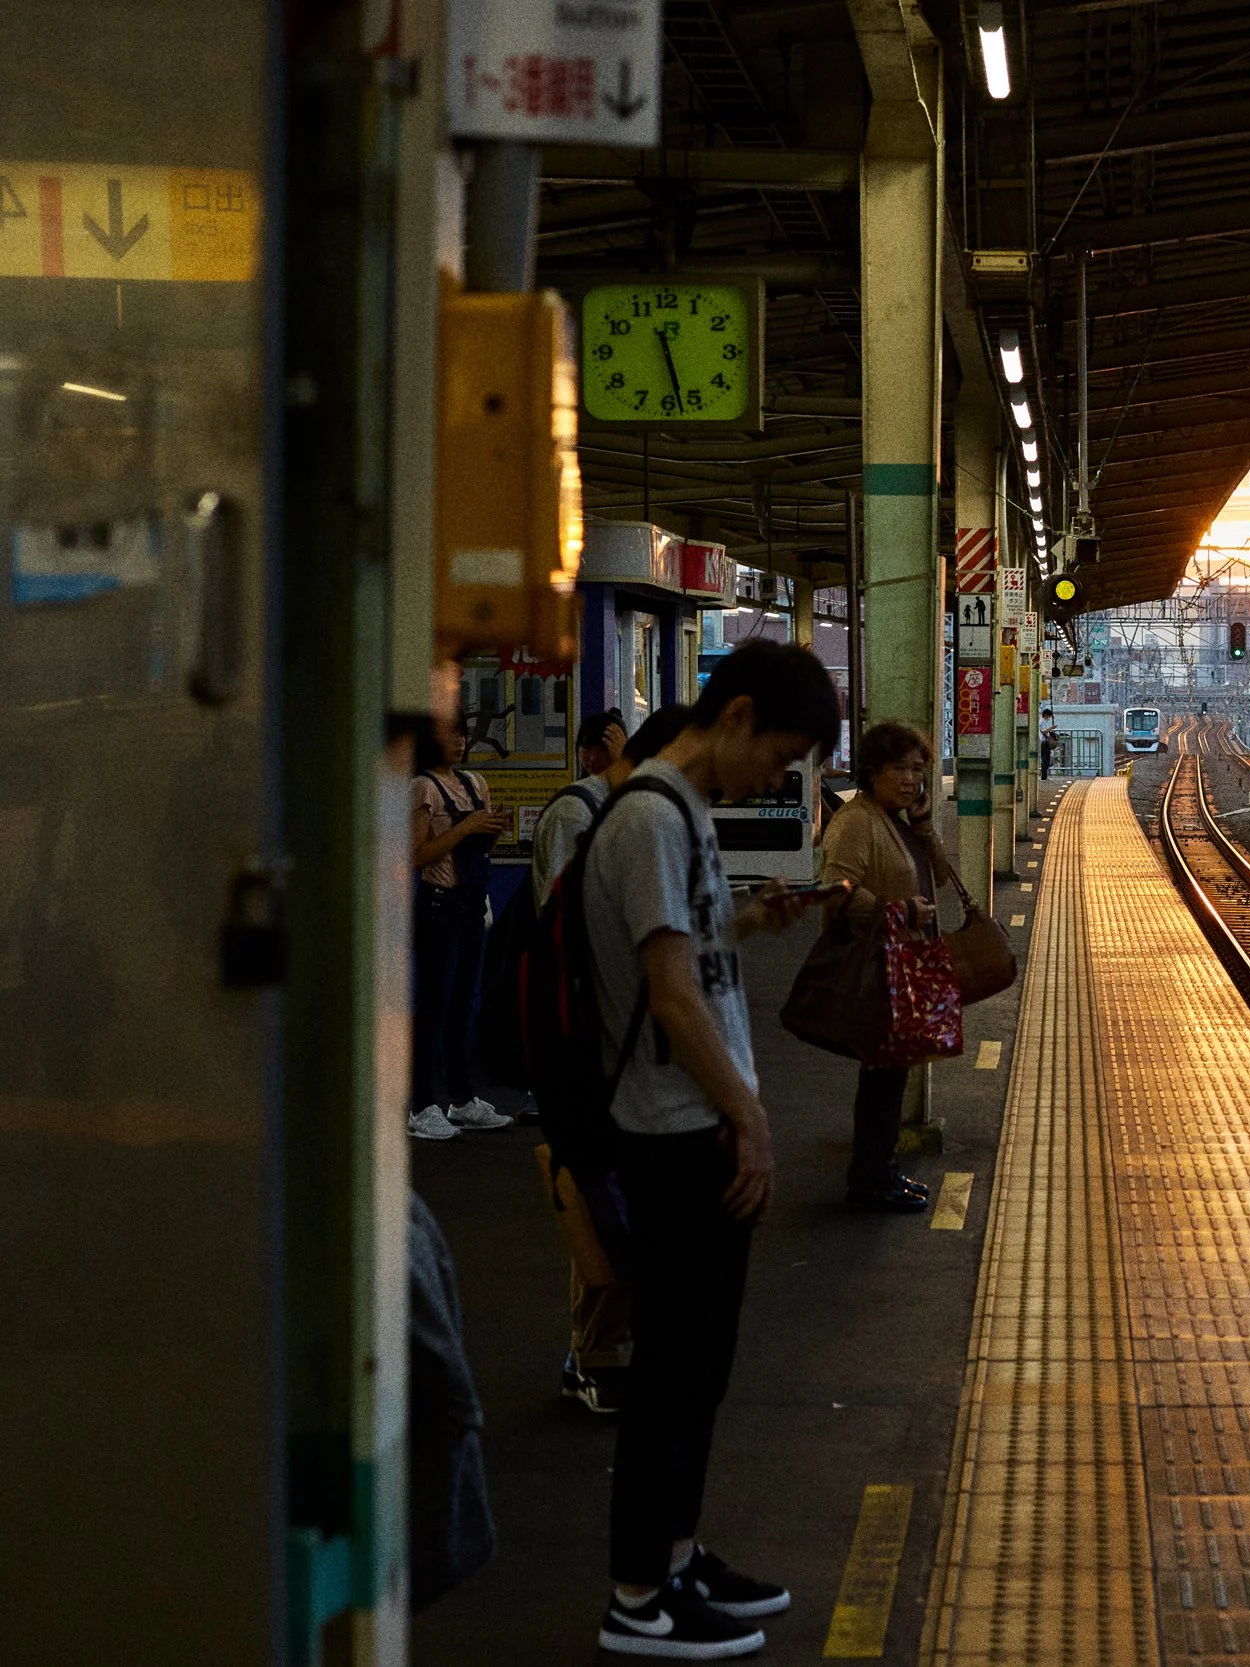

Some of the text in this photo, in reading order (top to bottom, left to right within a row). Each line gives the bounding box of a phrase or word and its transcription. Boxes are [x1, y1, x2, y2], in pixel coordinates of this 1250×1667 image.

[633, 301, 651, 317] 11
[655, 293, 679, 309] 12
[690, 299, 698, 315] 1
[609, 319, 631, 336] 10
[710, 316, 726, 332] 2
[597, 344, 613, 360] 9
[722, 343, 737, 360] 3
[610, 373, 625, 389] 8
[710, 372, 726, 388] 4
[635, 390, 649, 406] 7
[660, 395, 675, 411] 6
[687, 389, 702, 406] 5
[970, 689, 980, 726] 高円寺
[758, 808, 800, 817] acure
